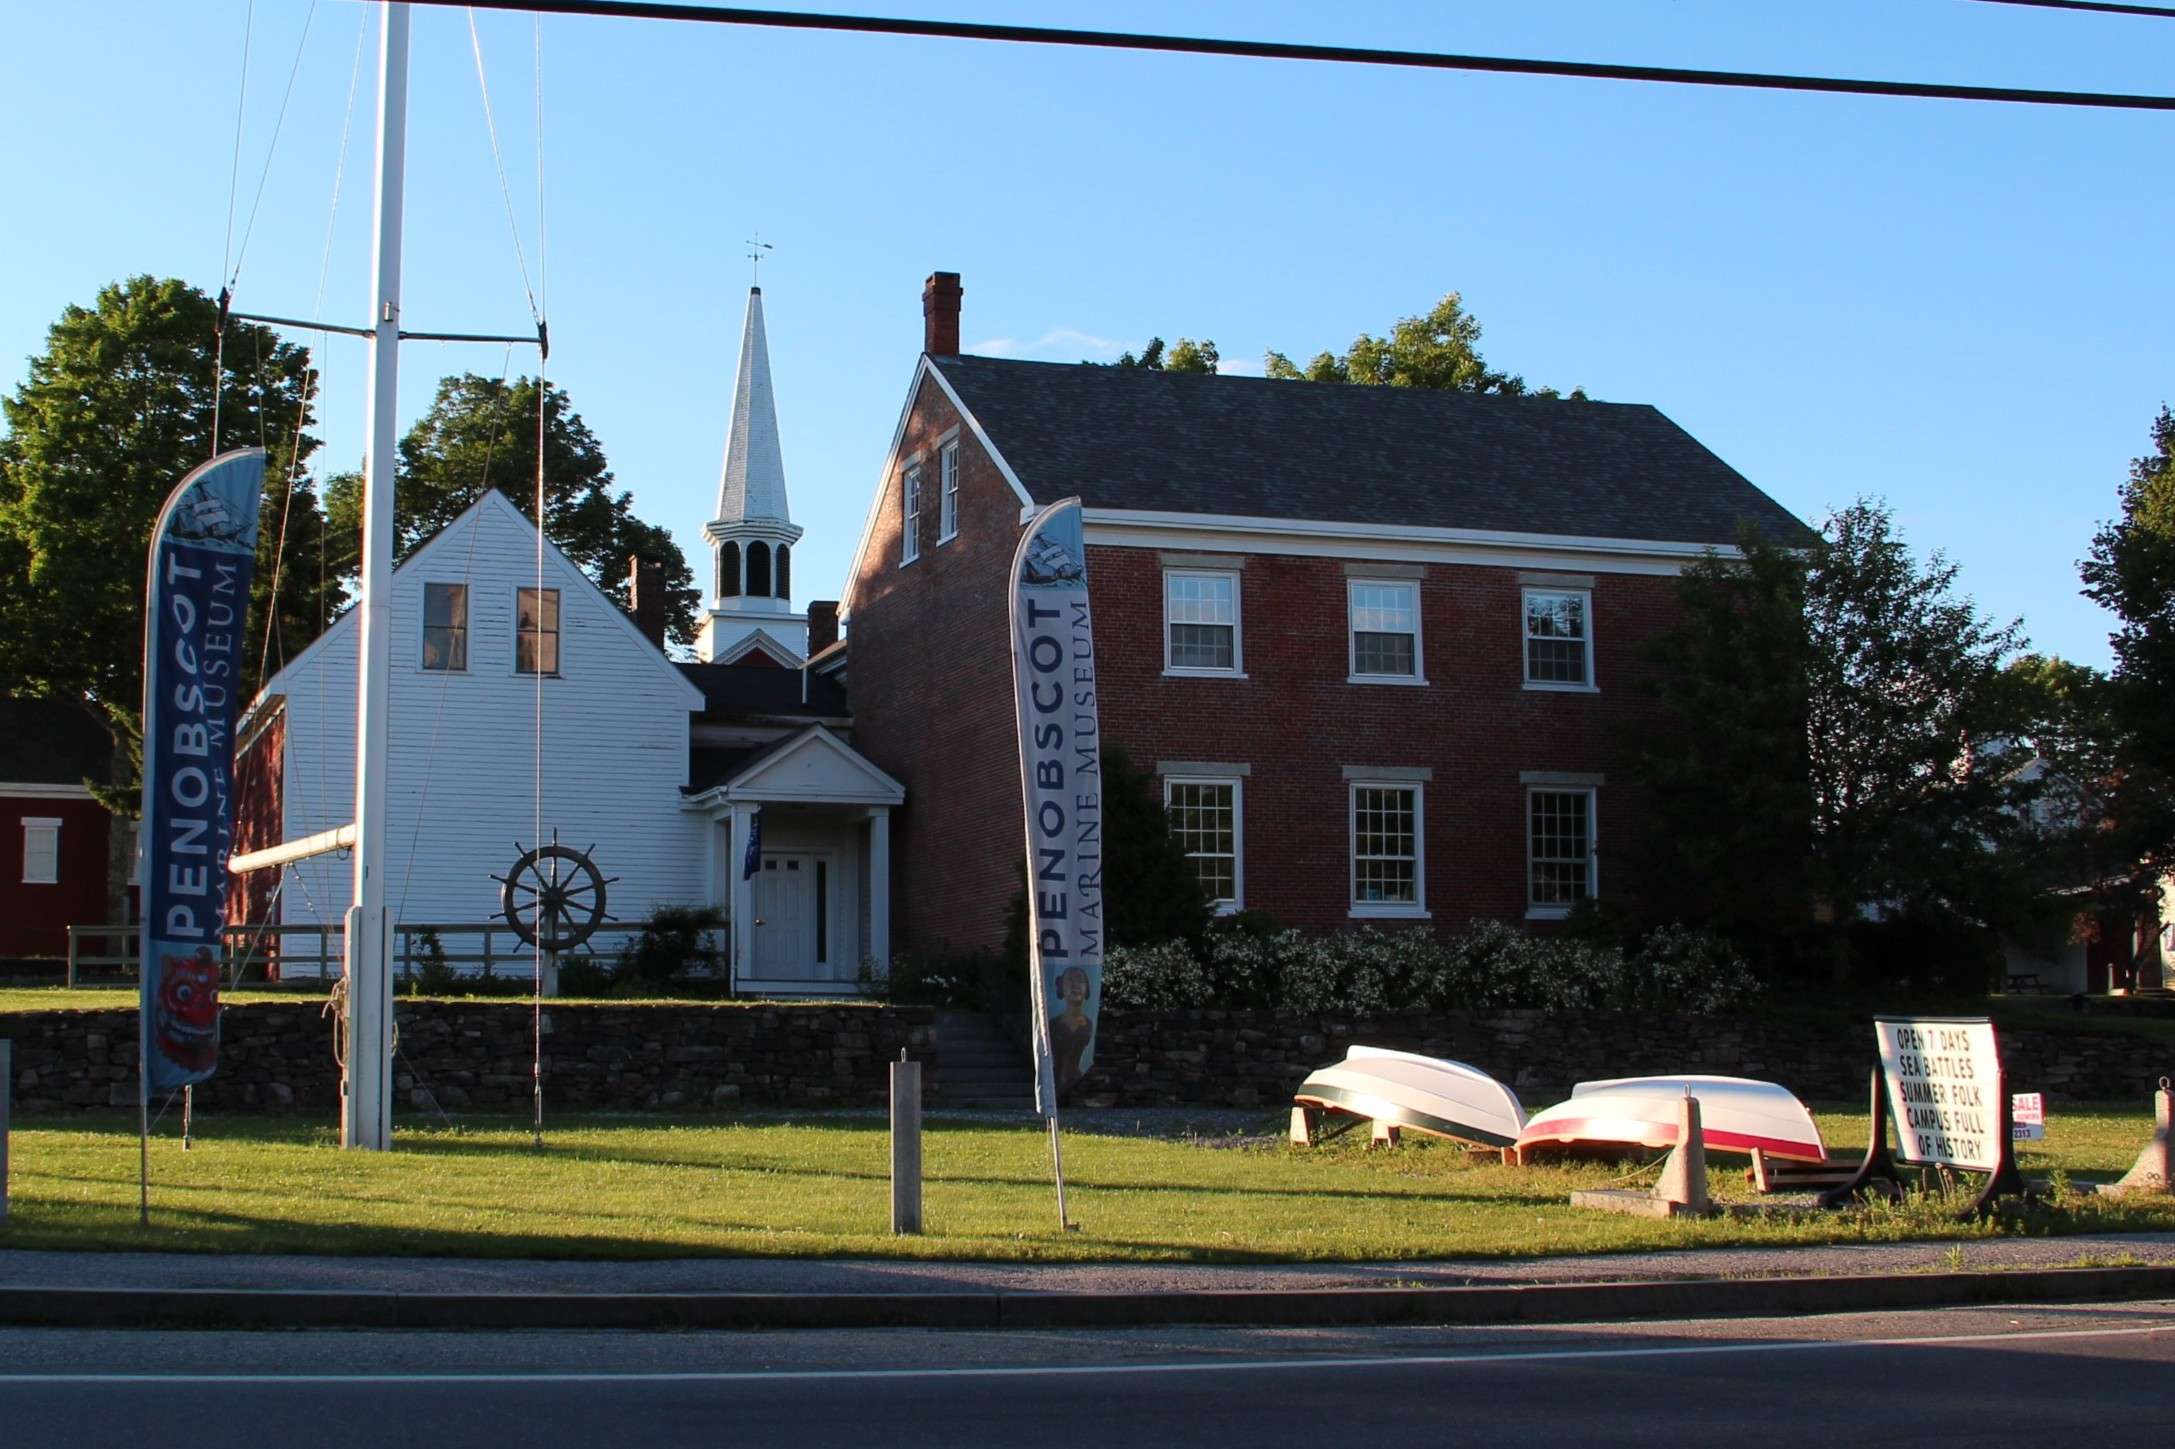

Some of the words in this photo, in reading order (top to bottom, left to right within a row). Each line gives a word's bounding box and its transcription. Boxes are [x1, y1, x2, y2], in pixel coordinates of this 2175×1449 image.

[203, 562, 238, 748] MUSEUM
[1070, 601, 1098, 776] MUSEUM
[166, 552, 209, 938] PENOBSCOT
[1027, 598, 1069, 958] PENOBSCOT
[213, 767, 229, 937] MARINE
[1076, 792, 1101, 957] MARINE
[1897, 1028, 1925, 1050] OPEN
[1927, 1030, 1934, 1050] 7
[1940, 1030, 1970, 1052] DAYS
[1900, 1055, 1921, 1076] SEA
[1922, 1057, 1974, 1079] BATTLES
[1900, 1081, 1947, 1104] SUMMER
[1952, 1085, 1983, 1107] FOLK
[1906, 1107, 1951, 1131] CAMPUS
[1954, 1111, 1984, 1134] FULL
[2012, 1096, 2039, 1111] SALE
[1918, 1134, 1931, 1156] OF
[1935, 1136, 1982, 1160] HISTORY
